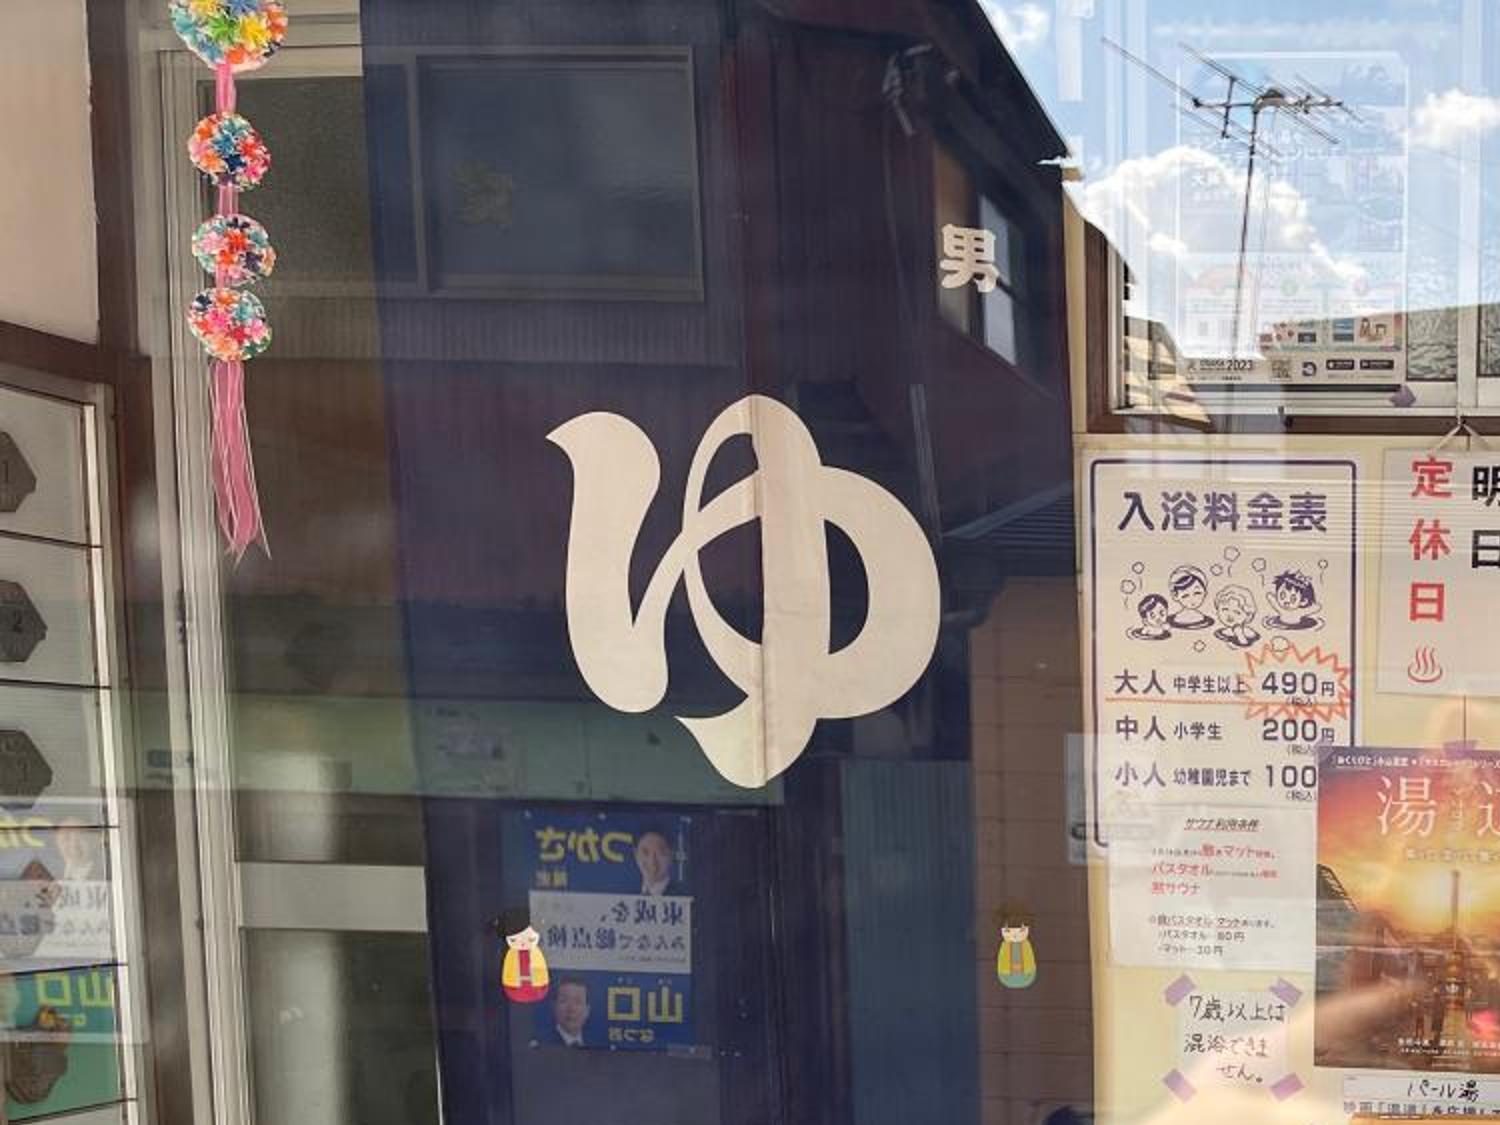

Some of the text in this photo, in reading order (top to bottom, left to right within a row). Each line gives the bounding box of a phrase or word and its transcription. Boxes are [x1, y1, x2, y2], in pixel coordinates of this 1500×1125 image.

[941, 223, 998, 292] 男
[1117, 490, 1328, 532] 入浴料金表
[1408, 455, 1454, 623] 定休日
[545, 394, 941, 788] ゆ
[1114, 669, 1335, 697] 大人 中学生以上 490円
[1115, 715, 1335, 743] 中人 小学生 200円
[1114, 762, 1166, 788] 小人
[1173, 768, 1251, 788] 幼稚園児まで
[1189, 994, 1285, 1022] 7歳以上は
[1184, 1032, 1269, 1056] 混浴できま
[1216, 1063, 1264, 1084] せん。
[1407, 1079, 1479, 1102] パール湯
